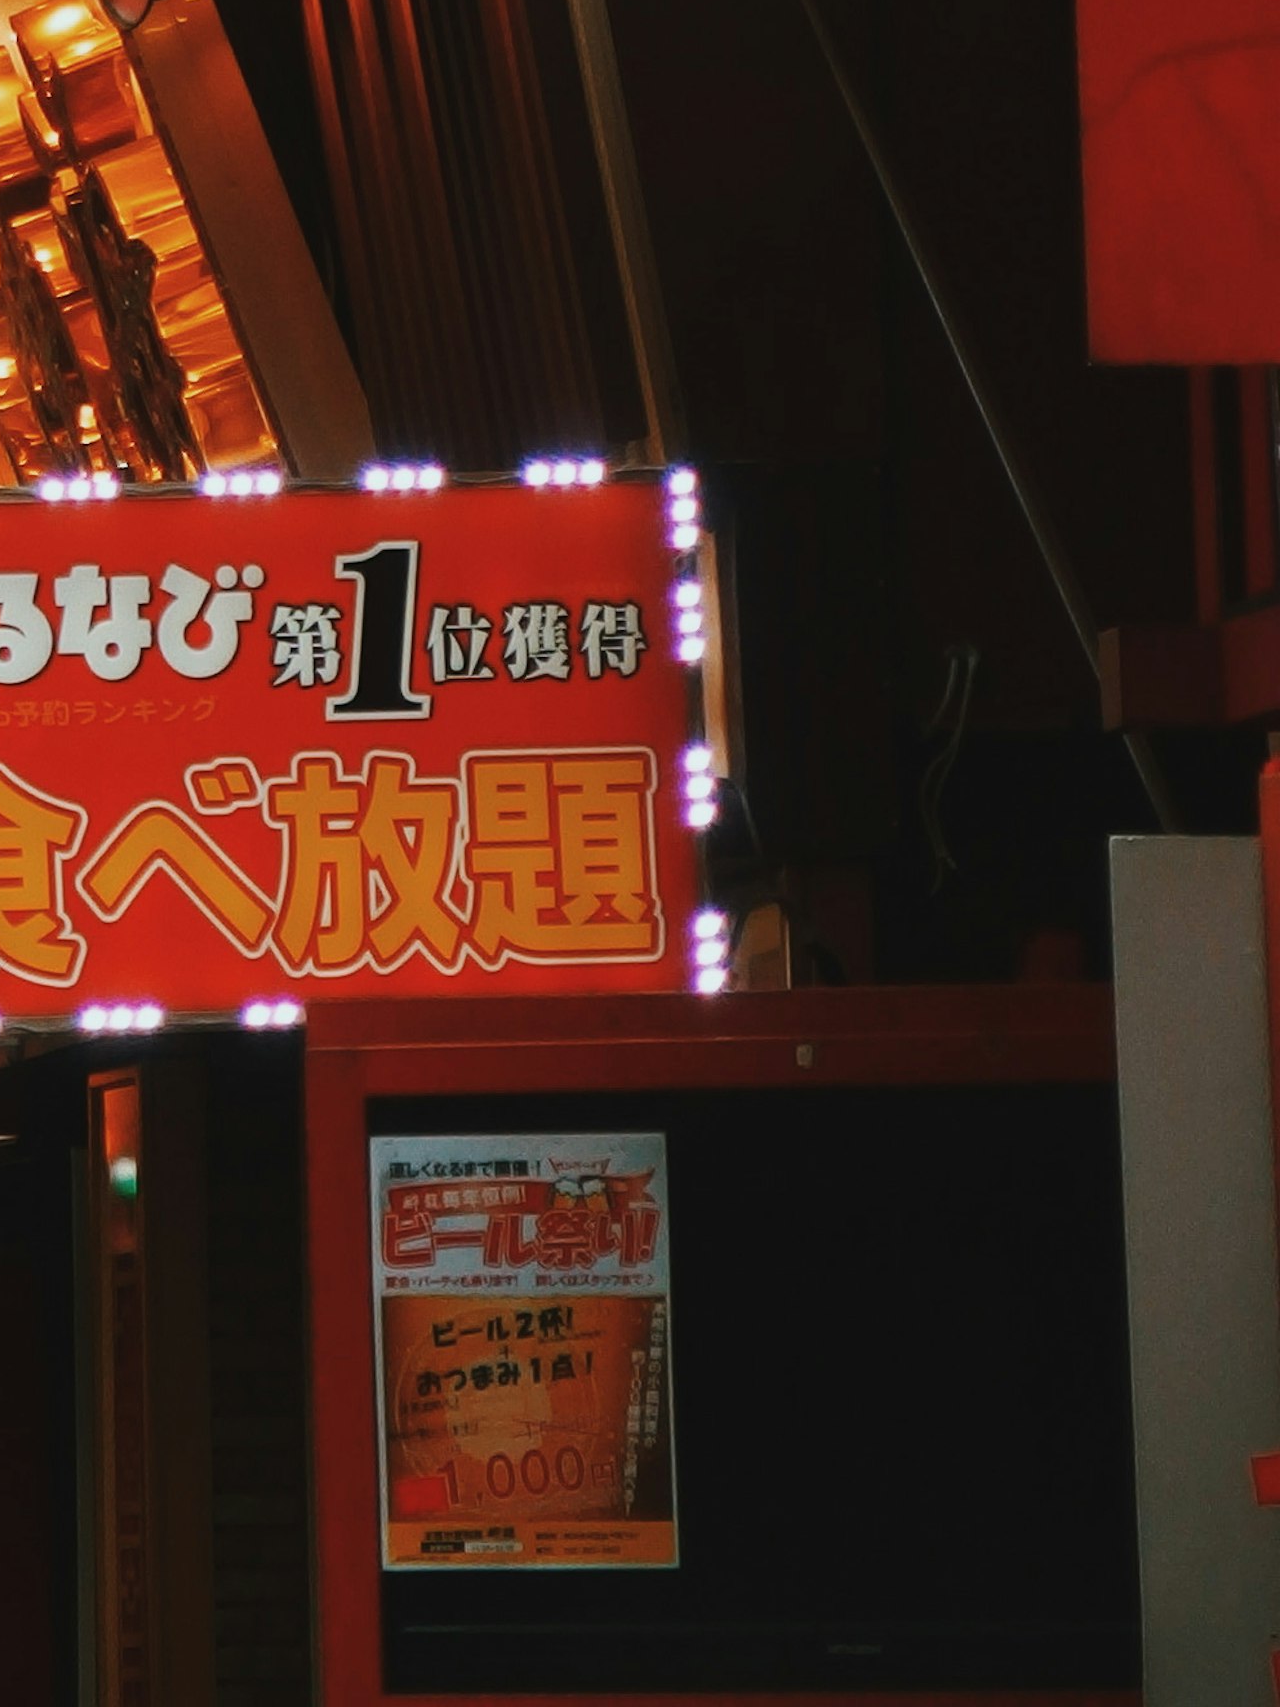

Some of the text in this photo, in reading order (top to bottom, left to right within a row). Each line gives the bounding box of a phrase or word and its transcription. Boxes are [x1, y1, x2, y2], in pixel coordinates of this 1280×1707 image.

[270, 539, 648, 723] 第1位獲得
[382, 1209, 660, 1271] ビール祭り！
